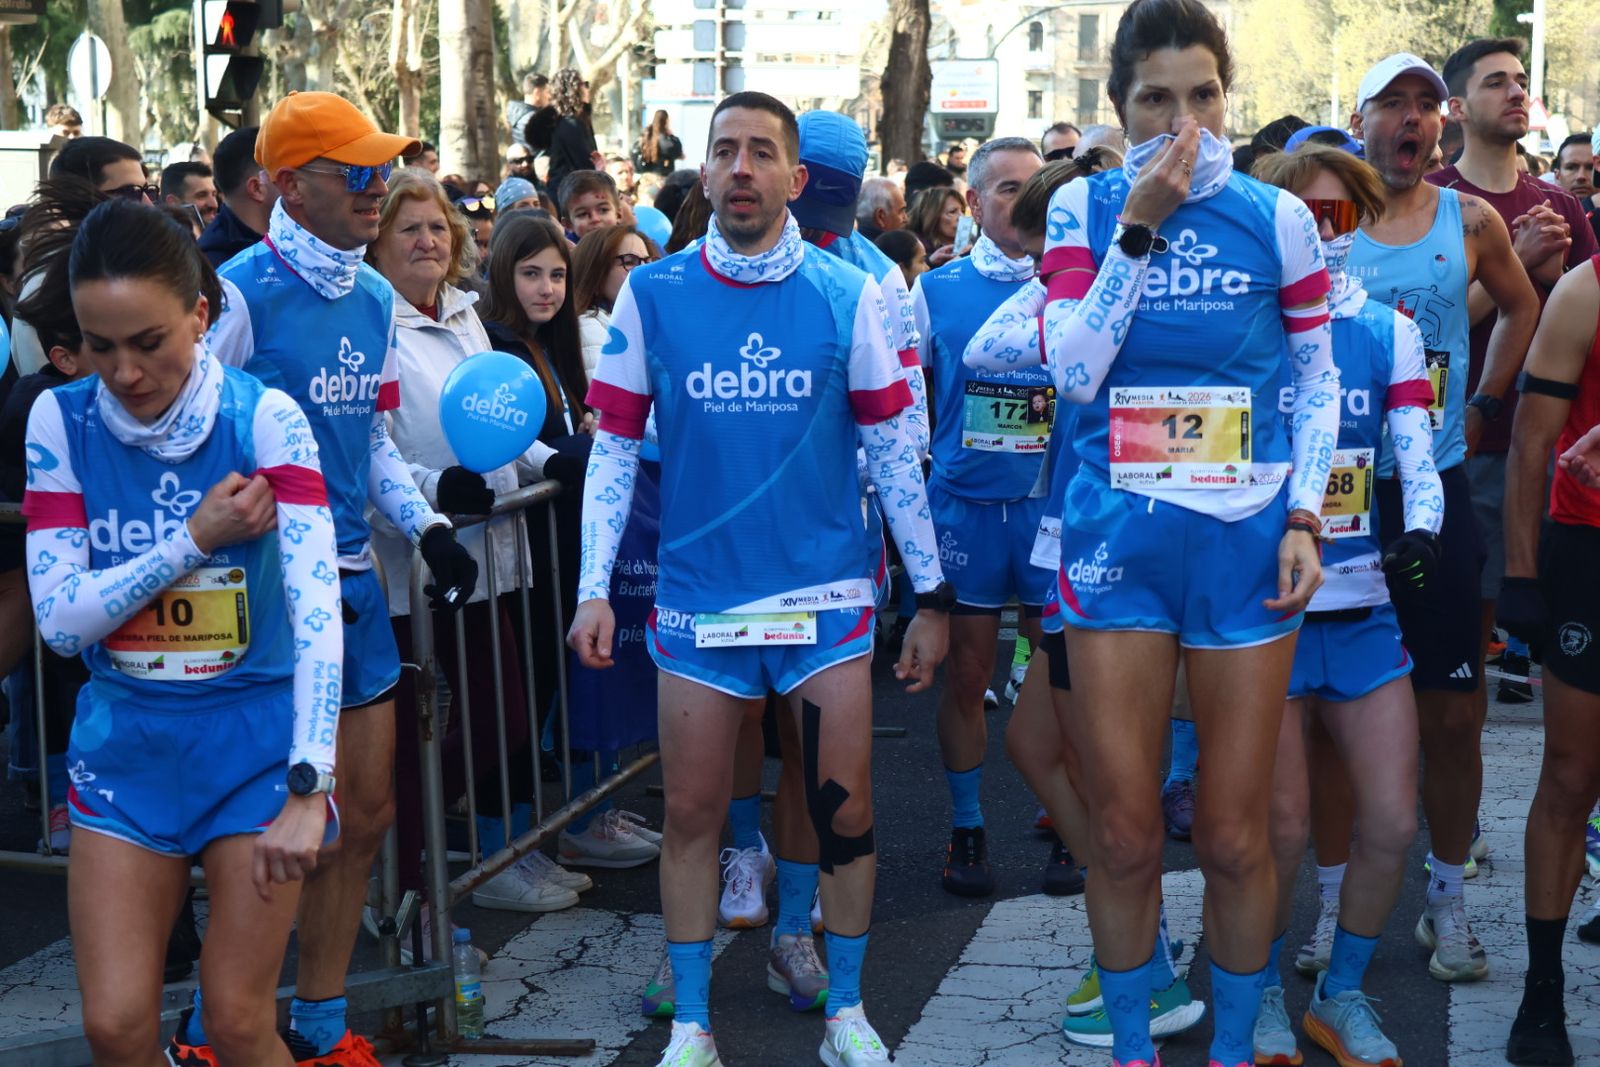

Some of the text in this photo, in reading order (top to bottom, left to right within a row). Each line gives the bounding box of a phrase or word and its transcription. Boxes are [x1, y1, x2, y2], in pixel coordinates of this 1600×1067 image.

[649, 273, 684, 281] LABORAL
[1142, 258, 1252, 298] ebra
[1086, 260, 1131, 334] debra
[1153, 300, 1170, 312] de
[1174, 298, 1235, 315] Mariposa
[686, 362, 812, 399] debra
[1007, 371, 1048, 383] Mariposa
[462, 392, 529, 427] debra
[704, 400, 798, 415] Piel de Mariposa
[1114, 392, 1131, 406] XIV
[1187, 391, 1212, 402] 2026
[1162, 414, 1203, 440] 12
[1118, 472, 1154, 480] LABORAL
[1258, 472, 1282, 483] 2026
[1326, 472, 1354, 495] 68
[90, 509, 184, 554] deb
[149, 552, 165, 568] Piel
[940, 543, 968, 567] bra
[135, 564, 148, 577] de
[1068, 557, 1124, 584] debra
[104, 562, 177, 619] debra
[150, 598, 194, 627] 10
[146, 634, 167, 642] PIEL
[169, 634, 181, 642] DE
[184, 633, 233, 642] MARIPOSA
[703, 631, 734, 639] LABORAL
[307, 660, 325, 743] Piel de Mariposa
